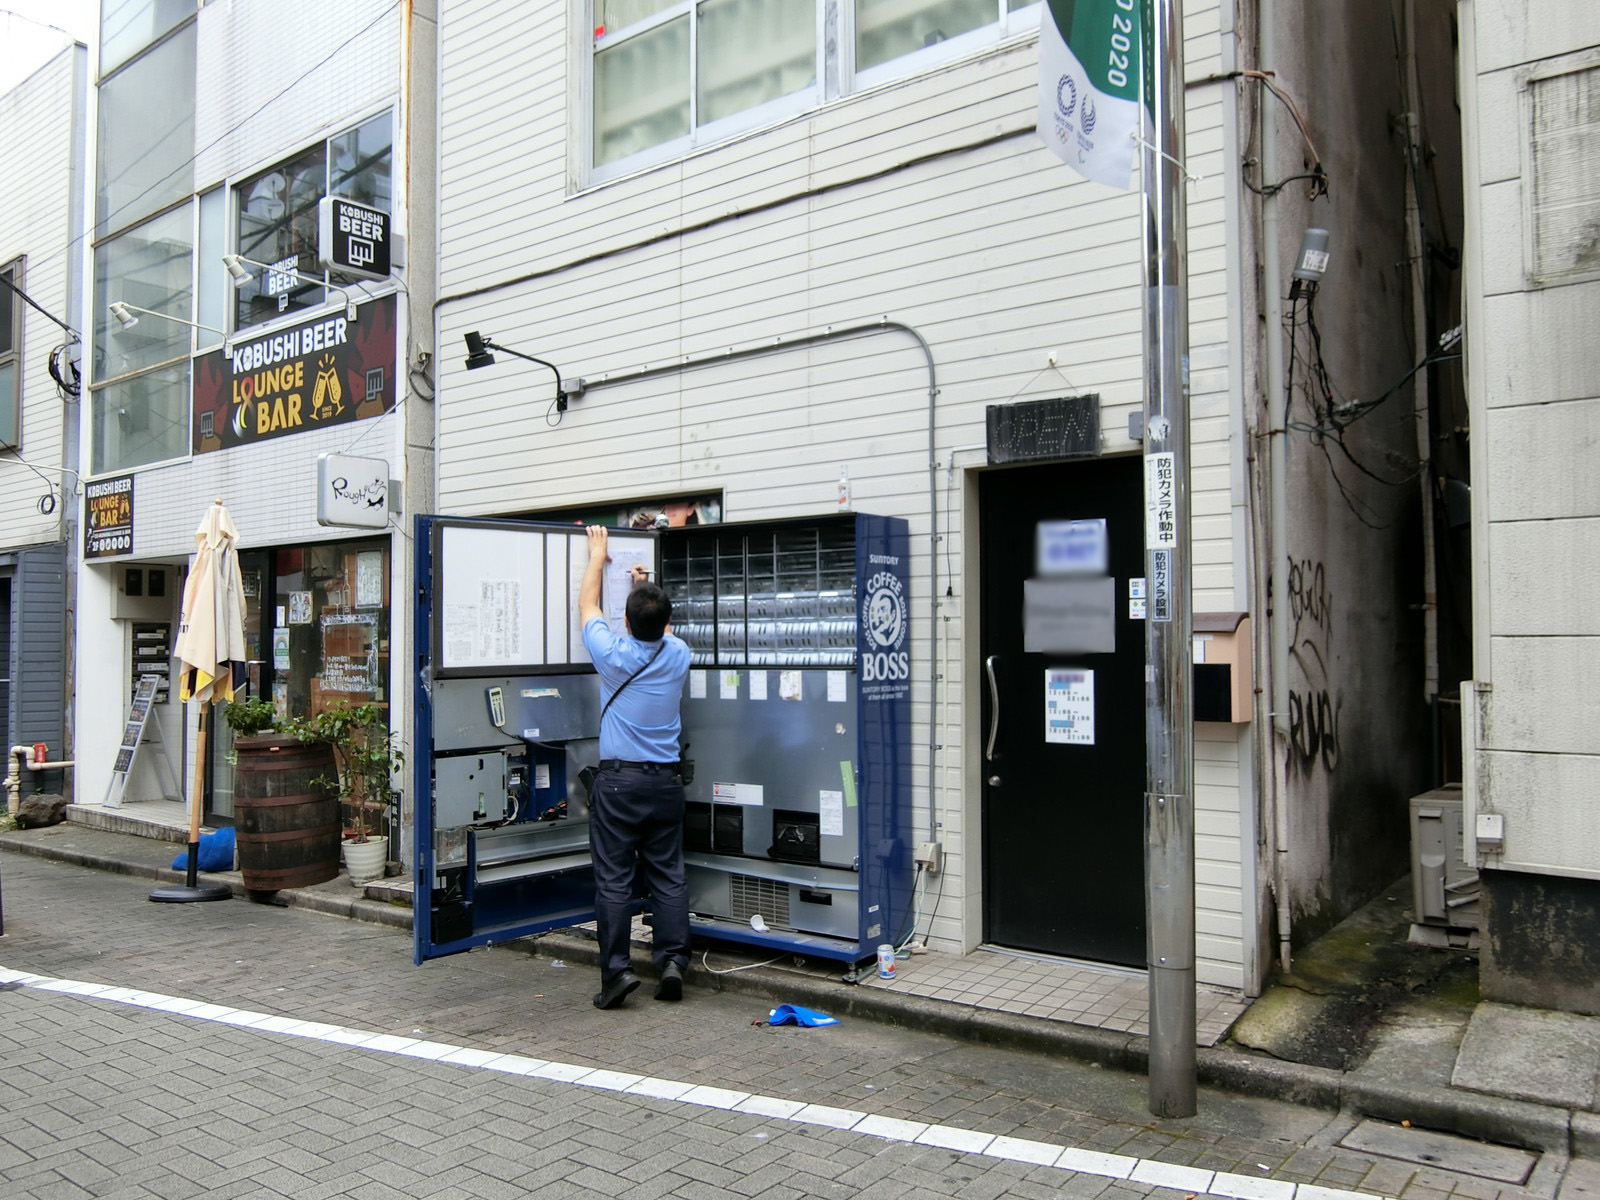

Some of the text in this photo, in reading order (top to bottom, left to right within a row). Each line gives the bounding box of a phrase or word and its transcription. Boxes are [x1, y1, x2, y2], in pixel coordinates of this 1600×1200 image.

[1107, 13, 1132, 88] 2020
[340, 204, 384, 226] KOBUSHI
[340, 215, 383, 242] BEER
[268, 268, 299, 296] BEER
[233, 317, 347, 374] KOBUSHI BEER
[232, 361, 304, 404] LOUNGE
[257, 393, 303, 434] BAR
[995, 412, 1090, 449] OPEN
[87, 479, 132, 499] KOBUSHI BEER
[90, 495, 119, 512] LOUNGE
[1157, 458, 1173, 543] 防犯カメラ作動中
[100, 509, 119, 527] BAR
[869, 554, 899, 566] SUNTORY
[867, 571, 903, 596] COFFEE
[1155, 552, 1167, 617] 防犯カメラ設置
[861, 651, 909, 681] BOSS
